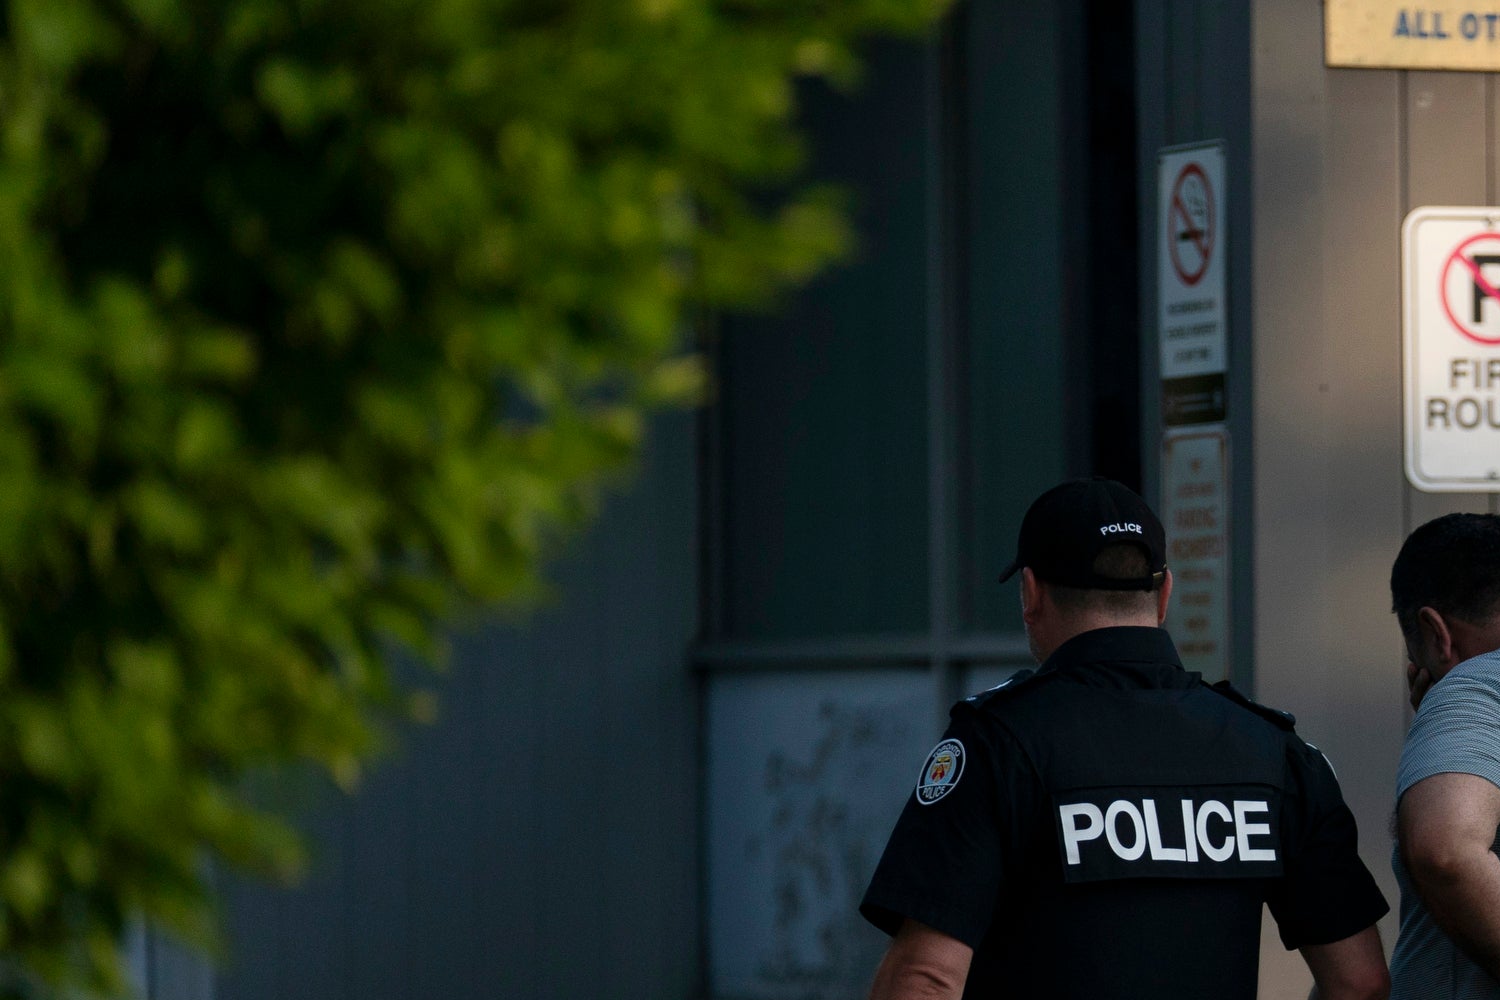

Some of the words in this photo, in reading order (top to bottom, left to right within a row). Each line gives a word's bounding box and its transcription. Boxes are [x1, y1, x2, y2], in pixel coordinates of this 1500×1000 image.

[1393, 11, 1450, 39] ALL
[1100, 522, 1142, 536] POLICE
[923, 786, 946, 799] POLICE
[1059, 799, 1276, 865] POLICE
